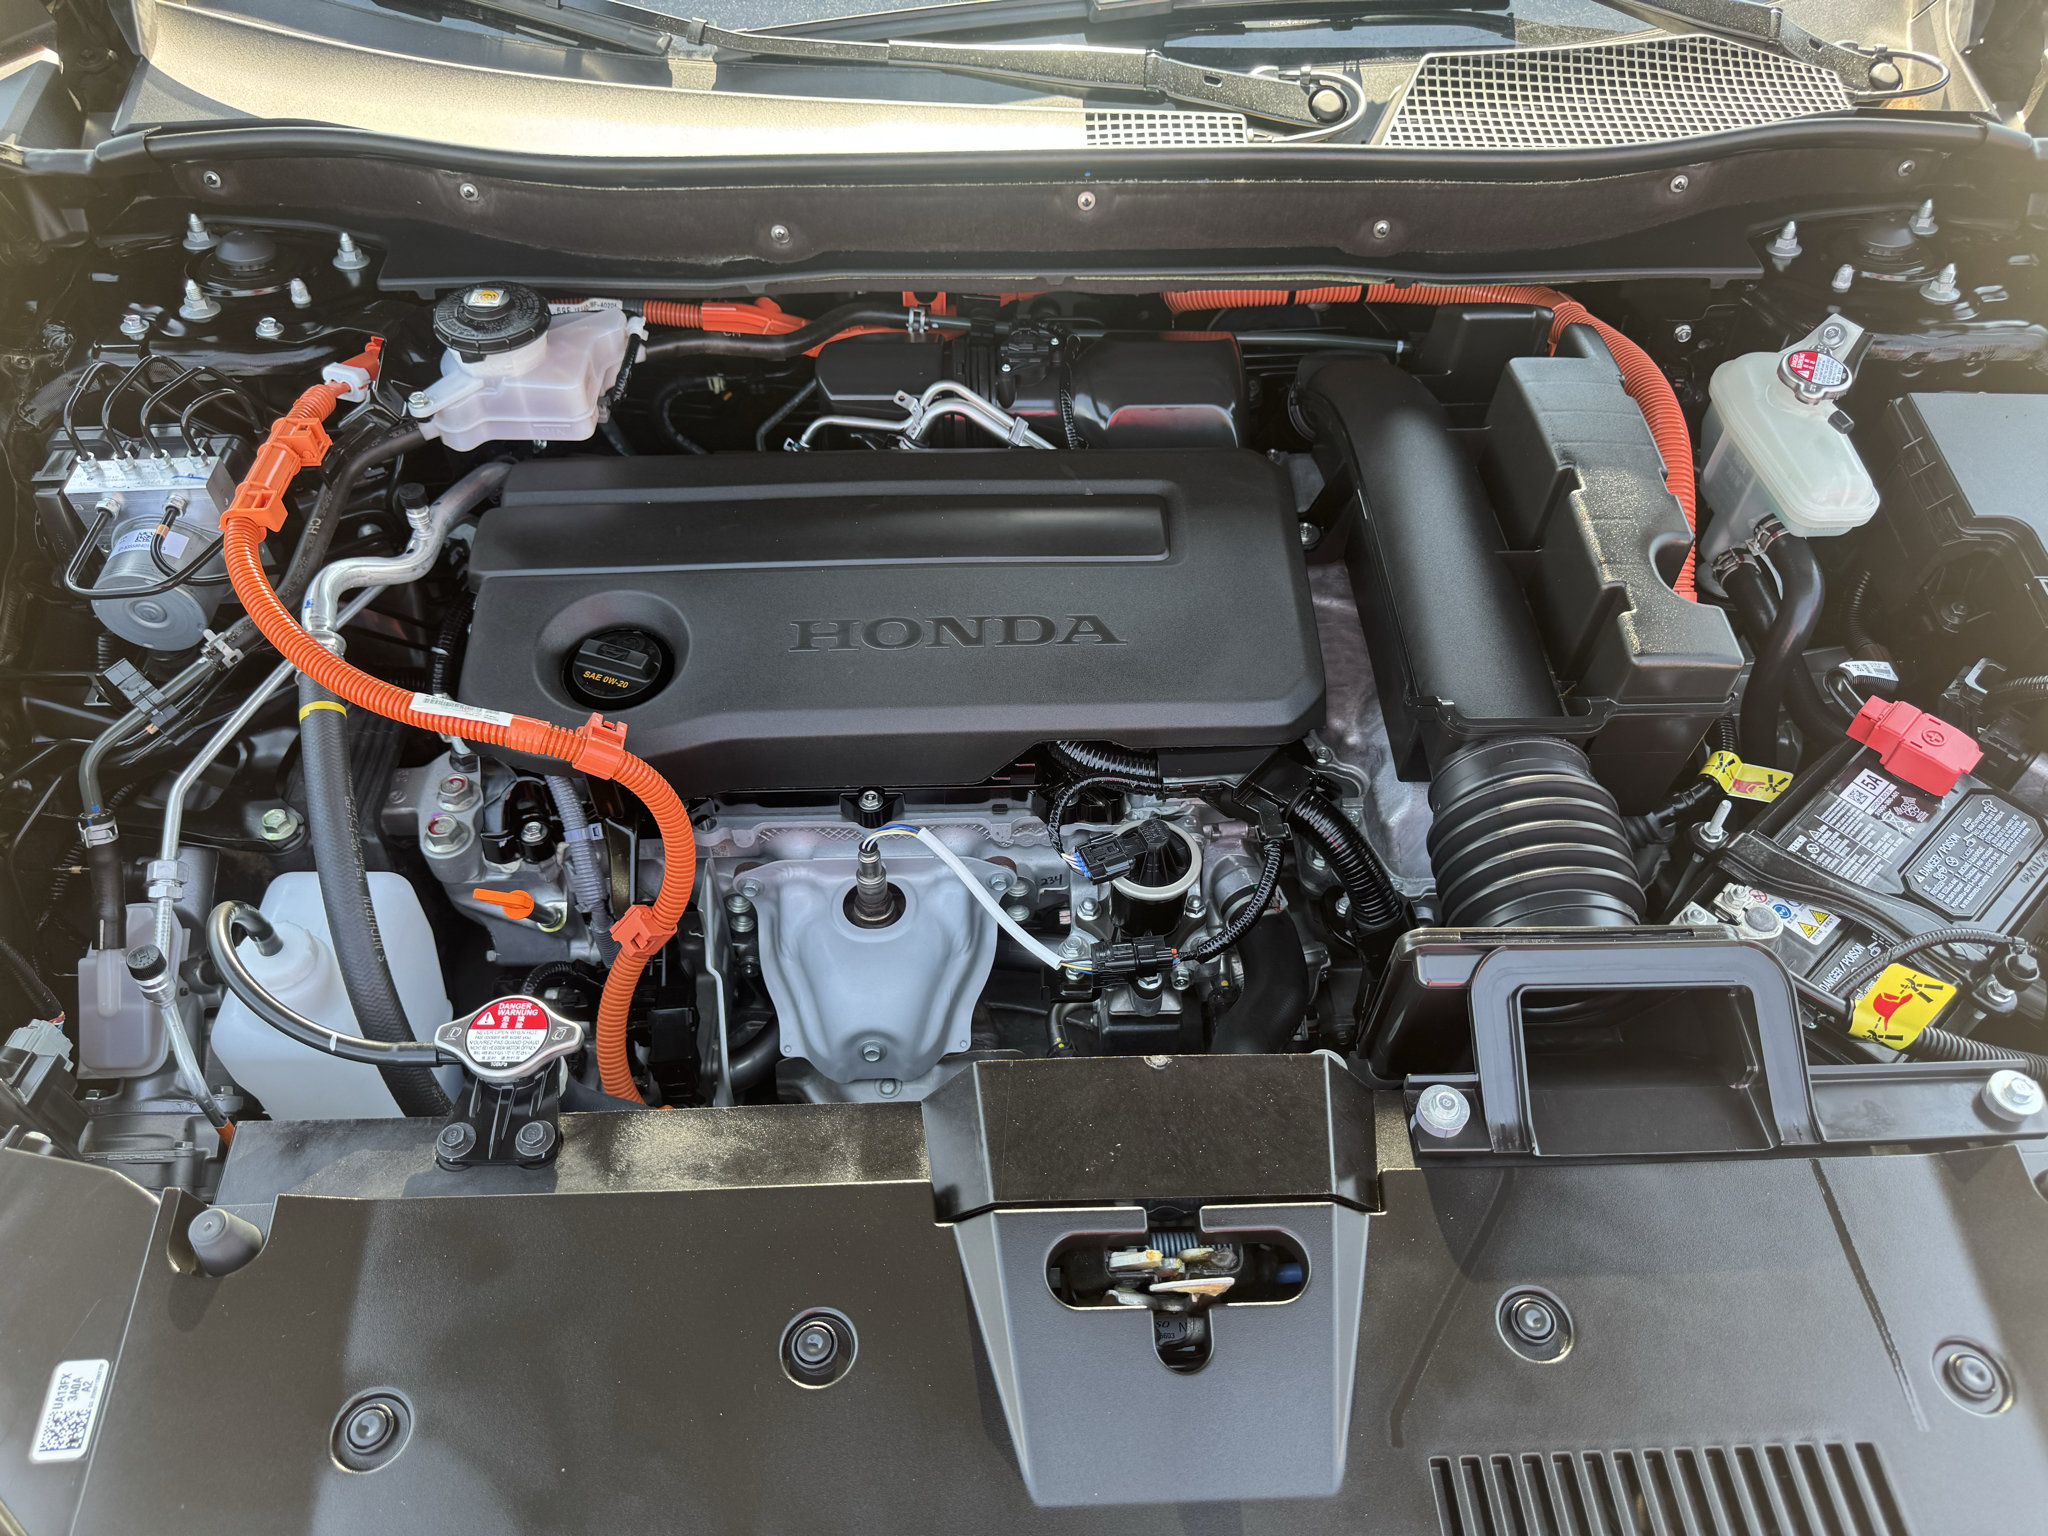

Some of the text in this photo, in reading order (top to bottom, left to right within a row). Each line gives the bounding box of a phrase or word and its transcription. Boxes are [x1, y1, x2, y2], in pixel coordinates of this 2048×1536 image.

[788, 614, 1128, 652] HONDA
[583, 671, 629, 689] SAE 0W-20
[1860, 774, 1884, 791] 5A
[1041, 874, 1062, 886] 234
[53, 1373, 73, 1410] UA13FX
[81, 1380, 93, 1393] A2
